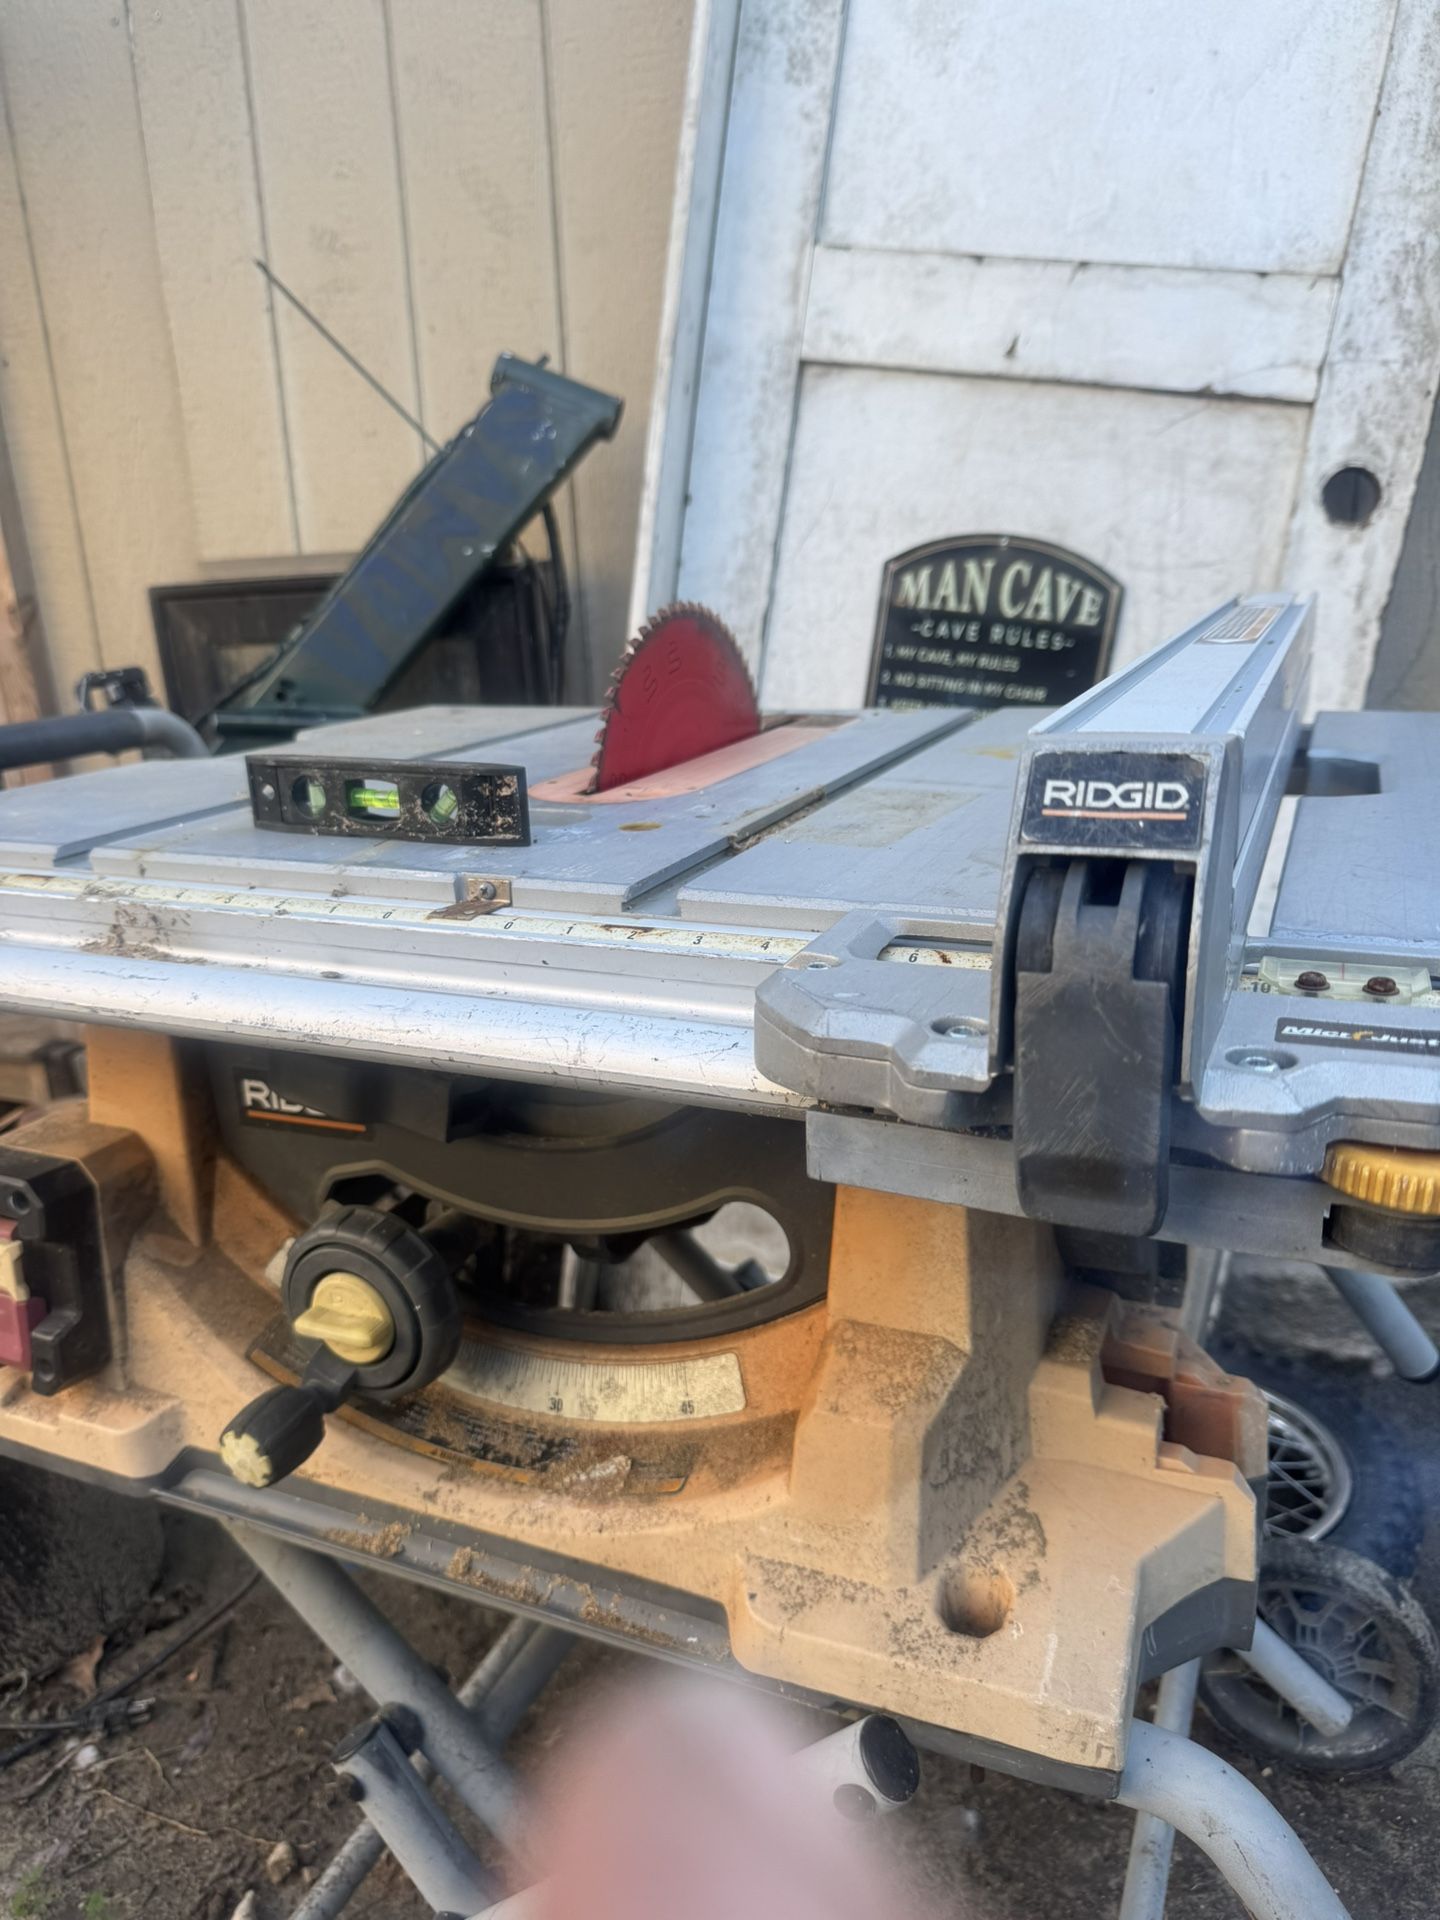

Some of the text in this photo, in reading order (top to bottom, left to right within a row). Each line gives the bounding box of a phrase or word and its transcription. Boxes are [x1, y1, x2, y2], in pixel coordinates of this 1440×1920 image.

[899, 559, 1103, 626] MAN CAVE
[1043, 779, 1189, 810] RIDGID
[503, 921, 514, 930] 0
[626, 931, 638, 940] 2
[692, 935, 704, 945] 3
[760, 941, 771, 951] 4
[908, 952, 919, 963] 6
[1251, 981, 1271, 993] 10
[549, 1397, 564, 1413] 30
